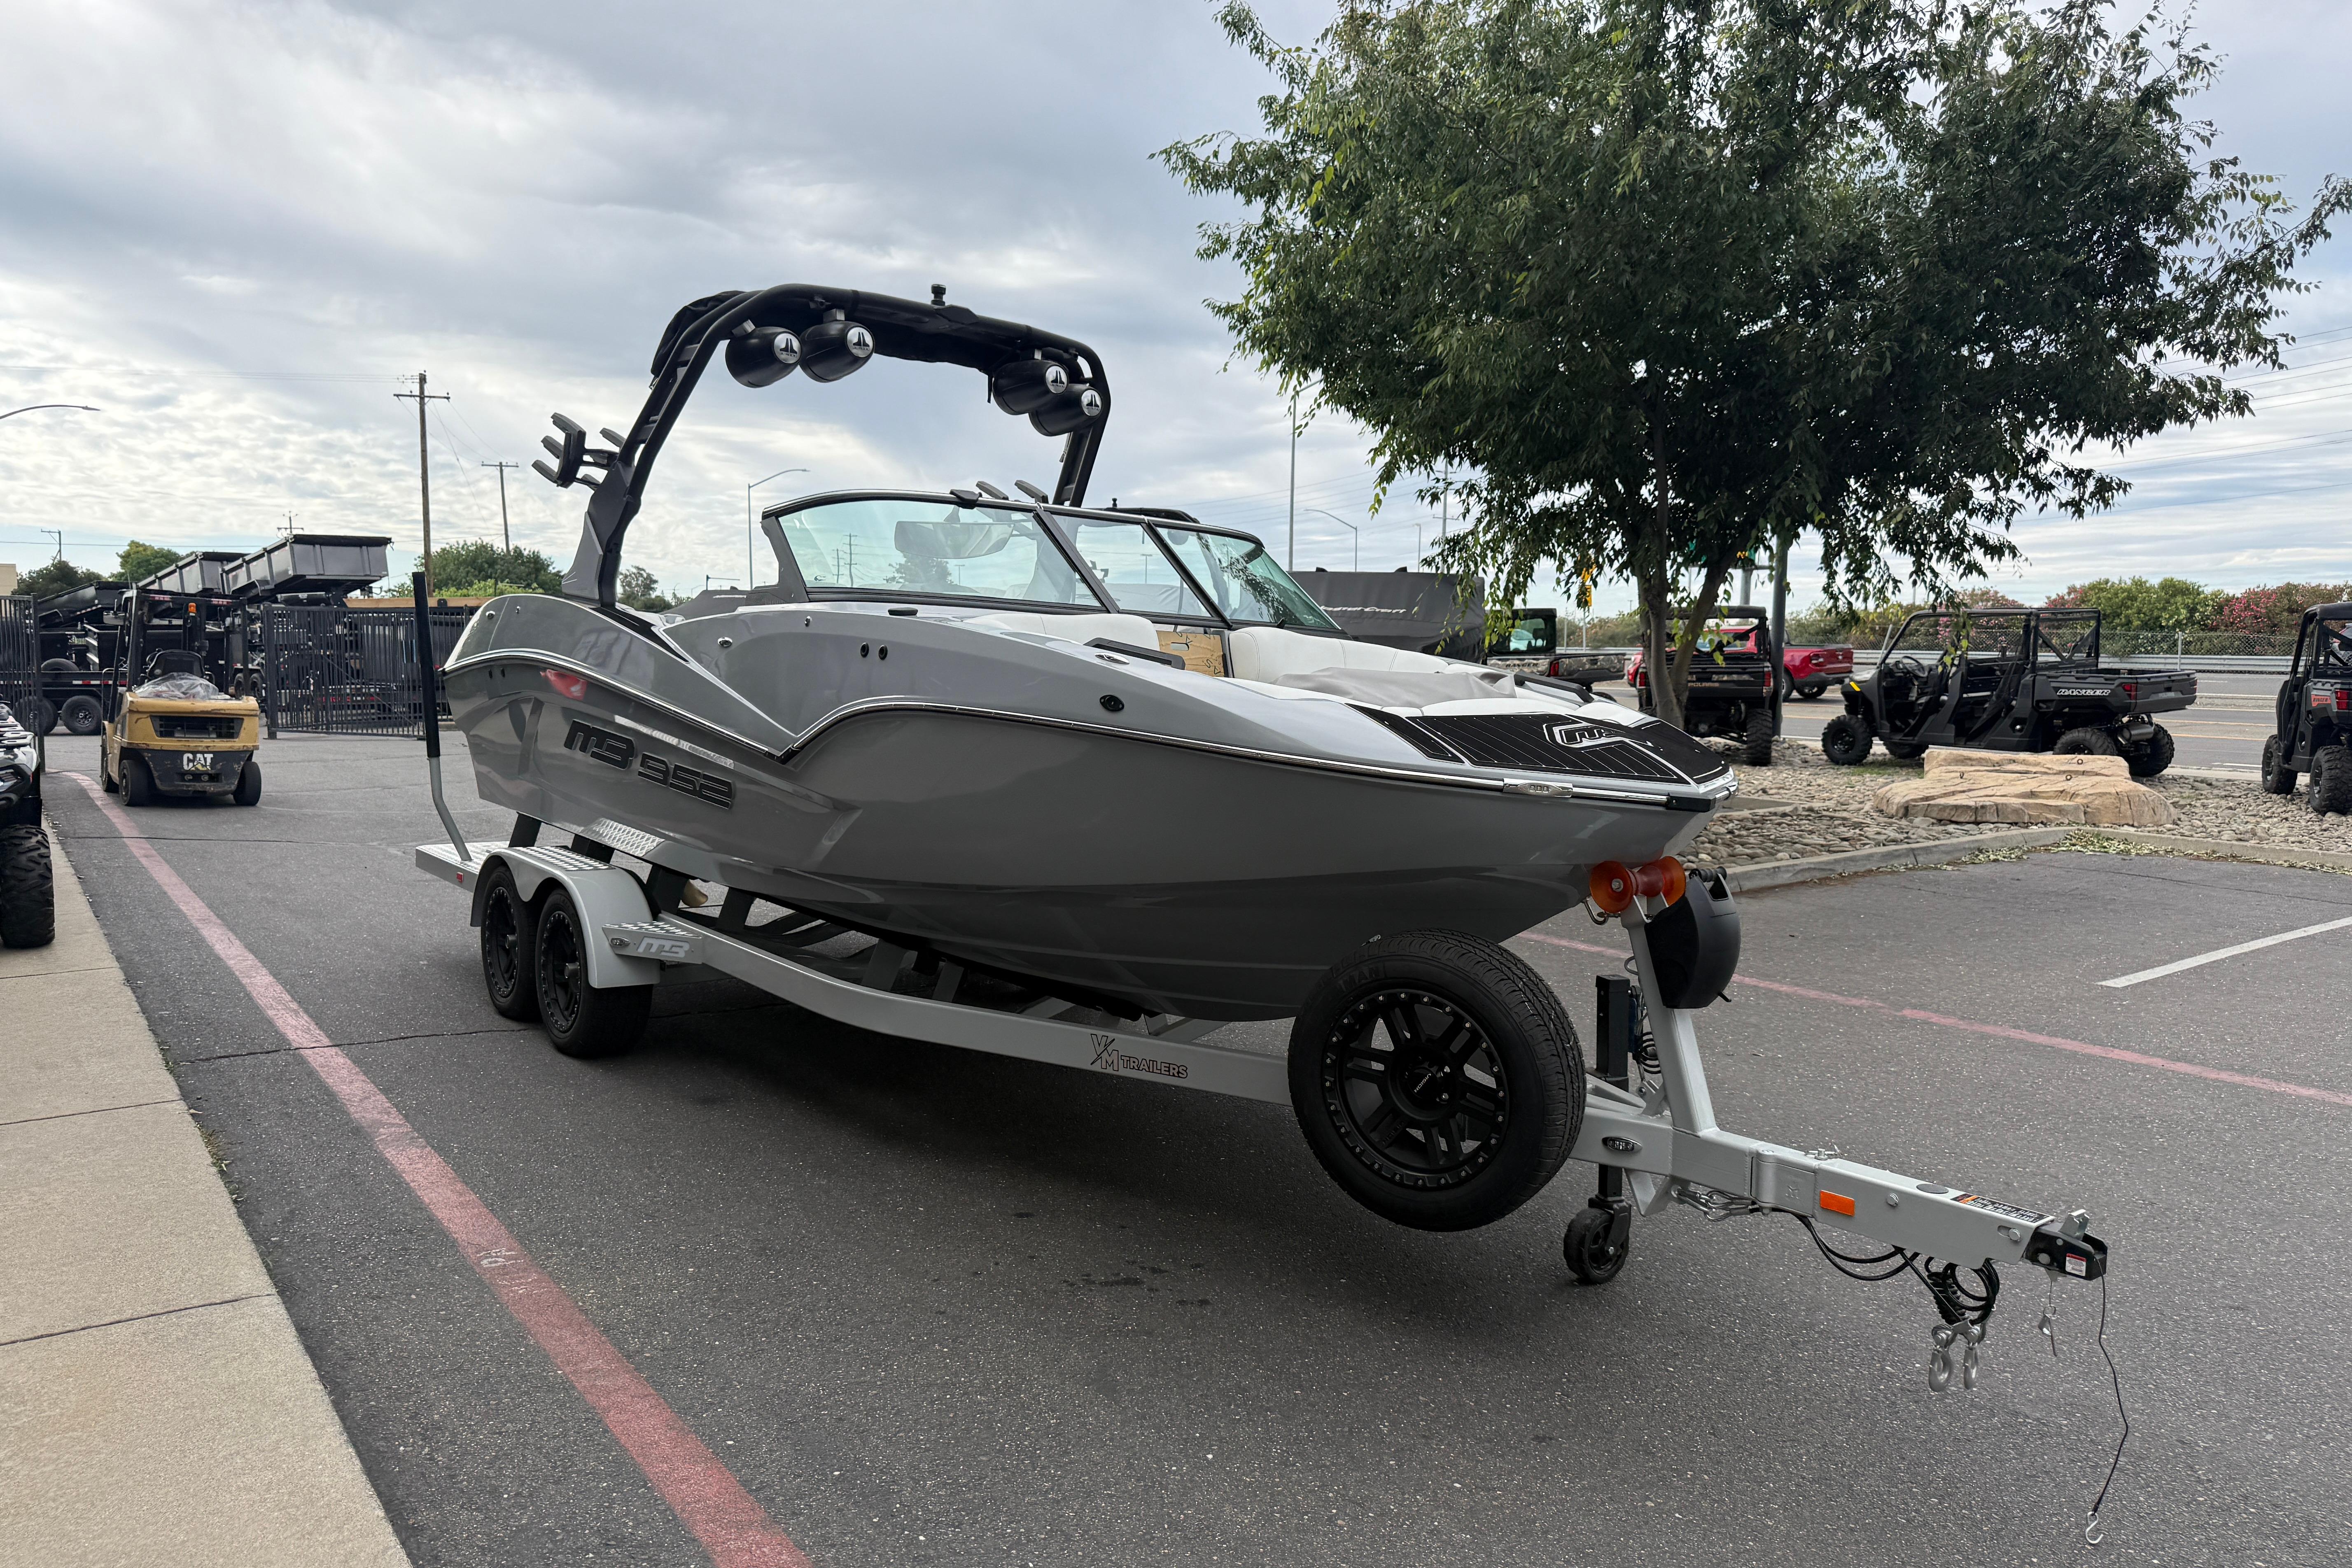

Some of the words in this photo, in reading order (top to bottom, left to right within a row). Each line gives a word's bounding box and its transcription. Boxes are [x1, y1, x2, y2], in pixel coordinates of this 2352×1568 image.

[564, 719, 637, 770] MB
[183, 753, 214, 770] CAT
[637, 936, 690, 958] MB
[1120, 1055, 1188, 1079] TRAILERS
